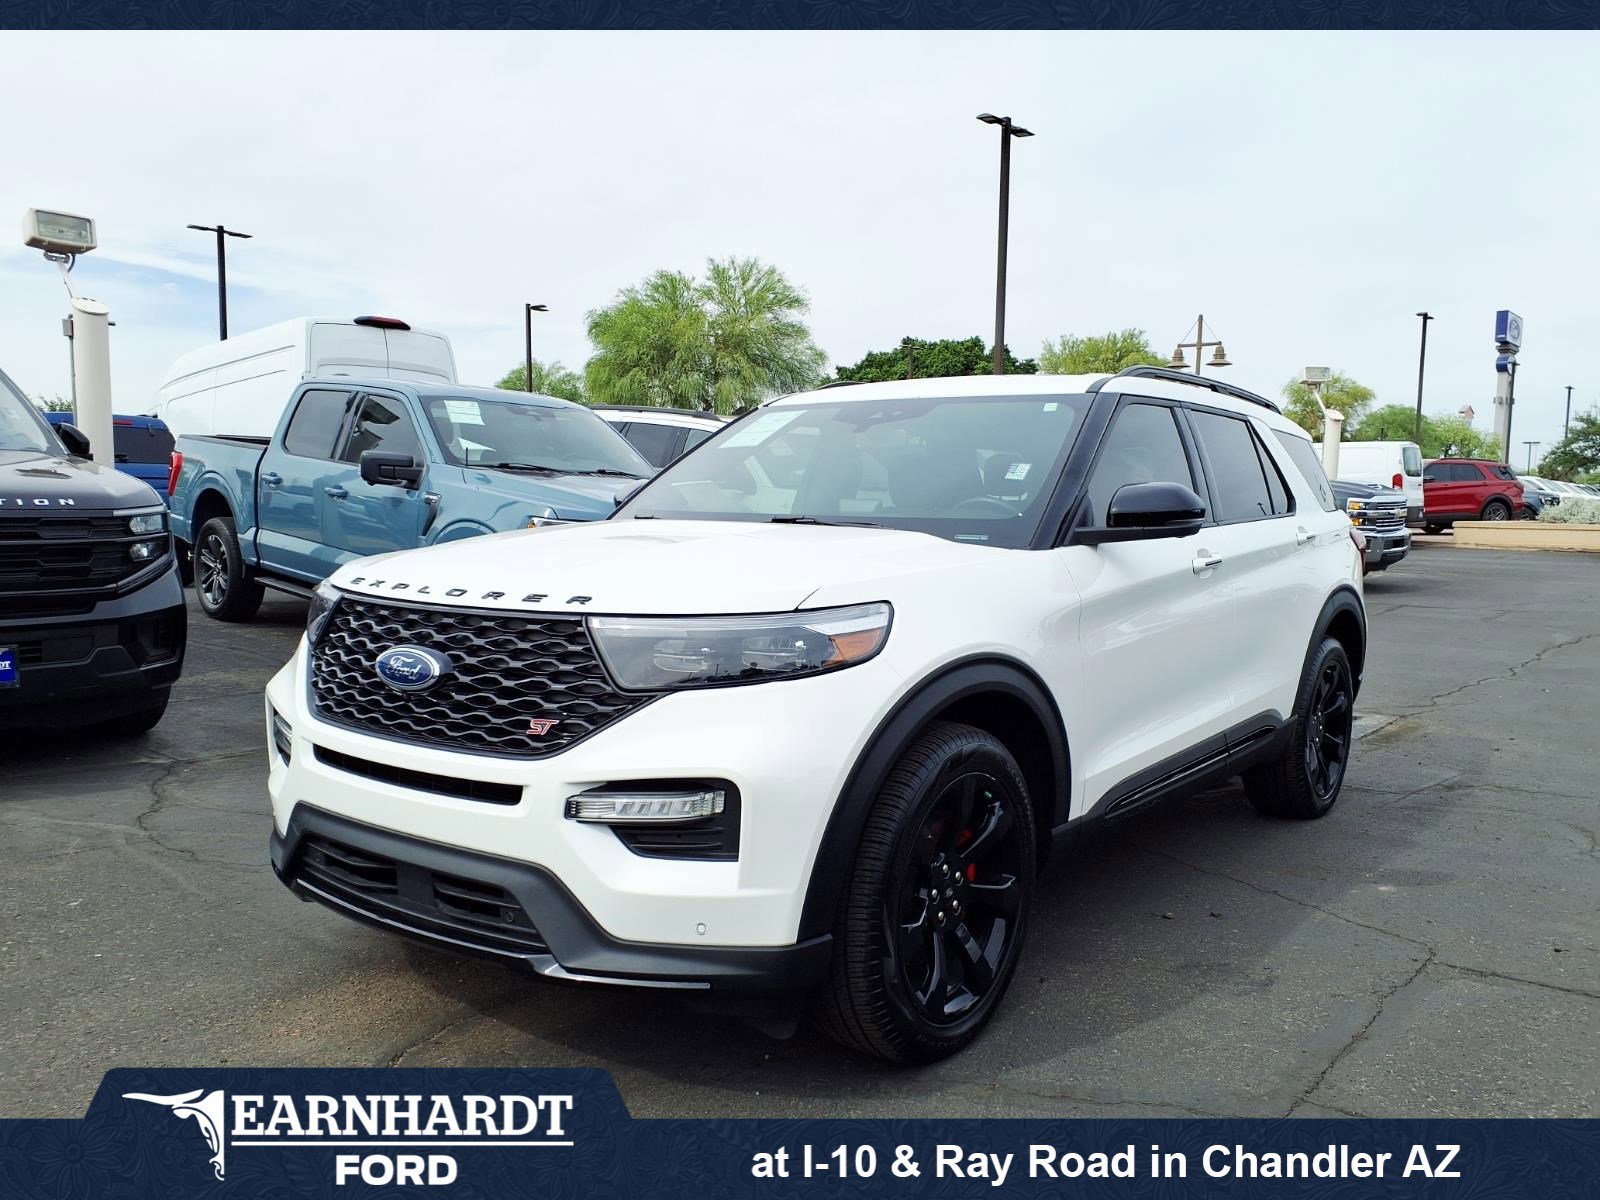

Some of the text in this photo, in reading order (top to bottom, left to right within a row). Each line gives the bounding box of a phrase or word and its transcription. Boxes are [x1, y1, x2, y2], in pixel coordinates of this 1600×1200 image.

[349, 576, 593, 606] EXPLORER
[385, 655, 423, 680] Ford
[526, 719, 560, 735] ST
